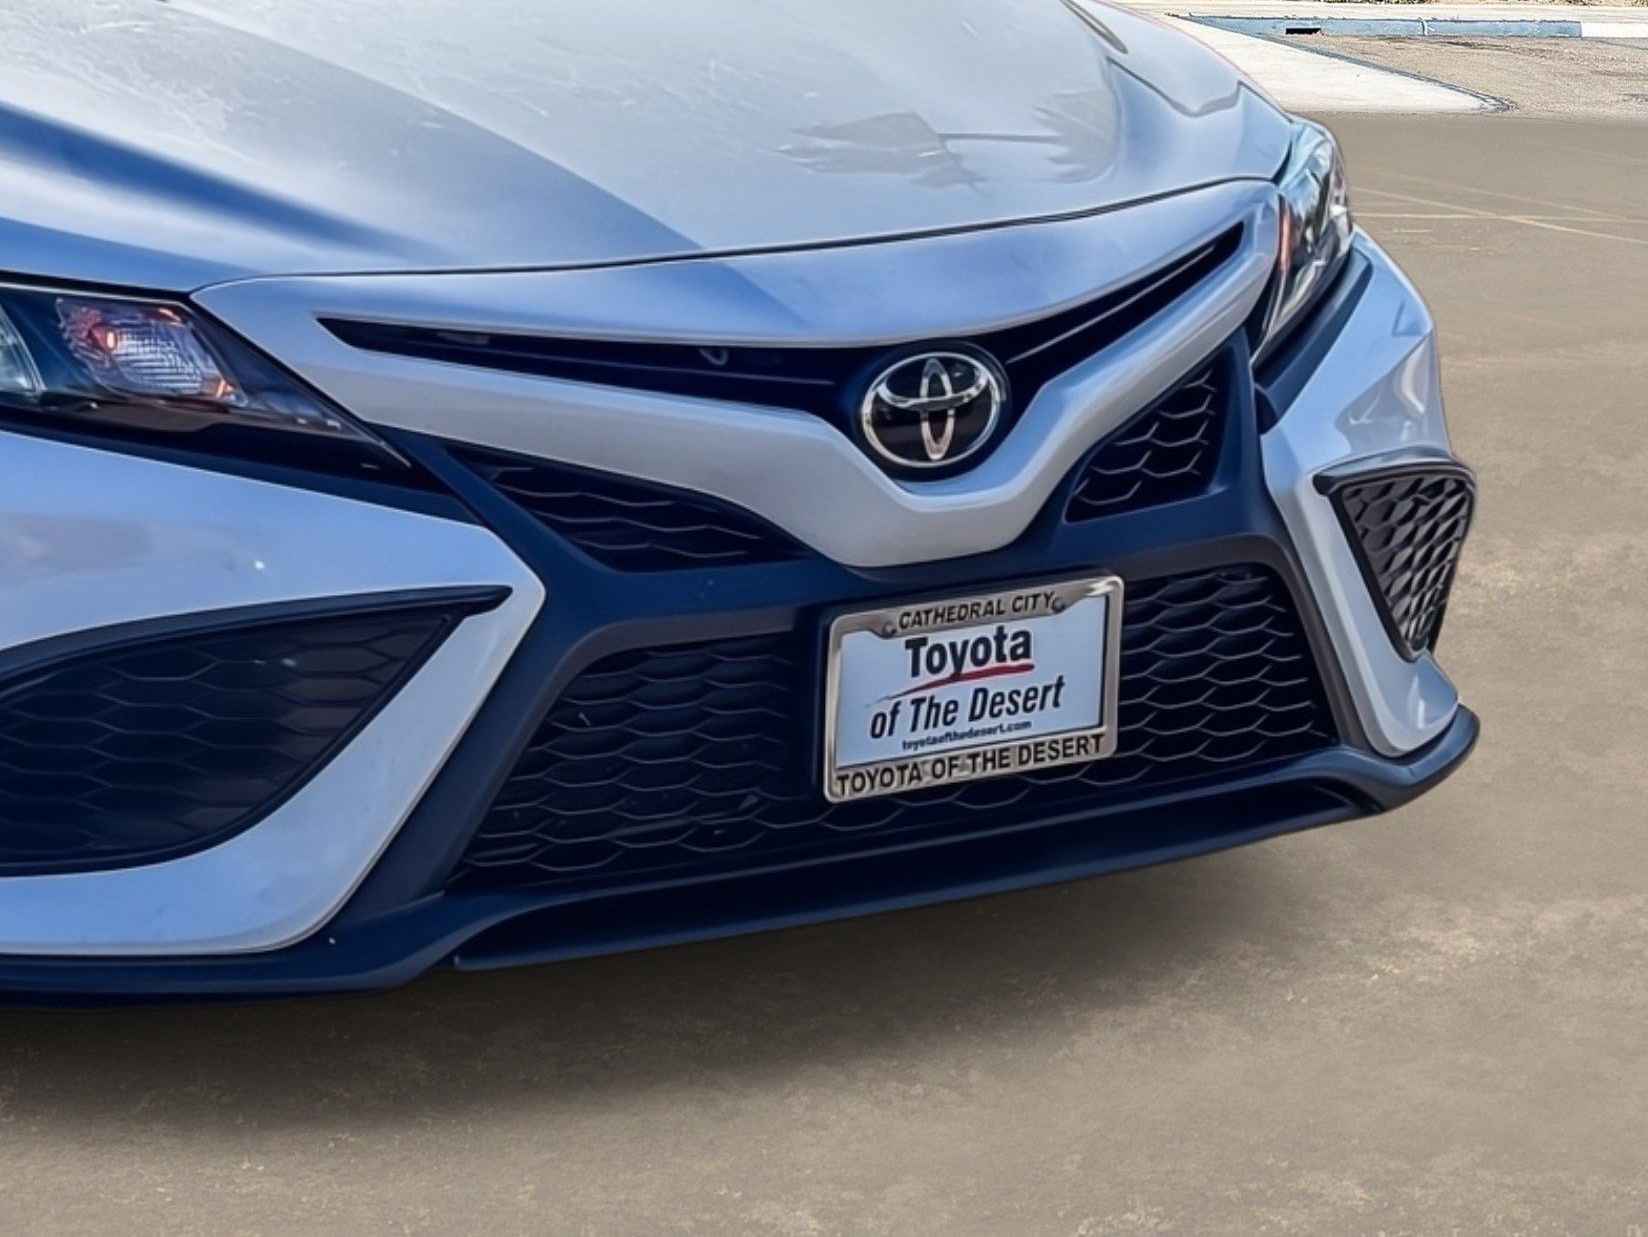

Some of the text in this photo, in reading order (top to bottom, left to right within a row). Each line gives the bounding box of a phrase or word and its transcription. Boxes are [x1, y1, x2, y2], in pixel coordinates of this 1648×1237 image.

[898, 591, 1055, 630] CATHEDRAL CITY
[904, 624, 1033, 681] Toyota
[870, 675, 1065, 739] of The Desert
[901, 720, 1032, 751] toyotaofthedesert.com
[836, 733, 1105, 796] TOYOTA OF THE DESERT
